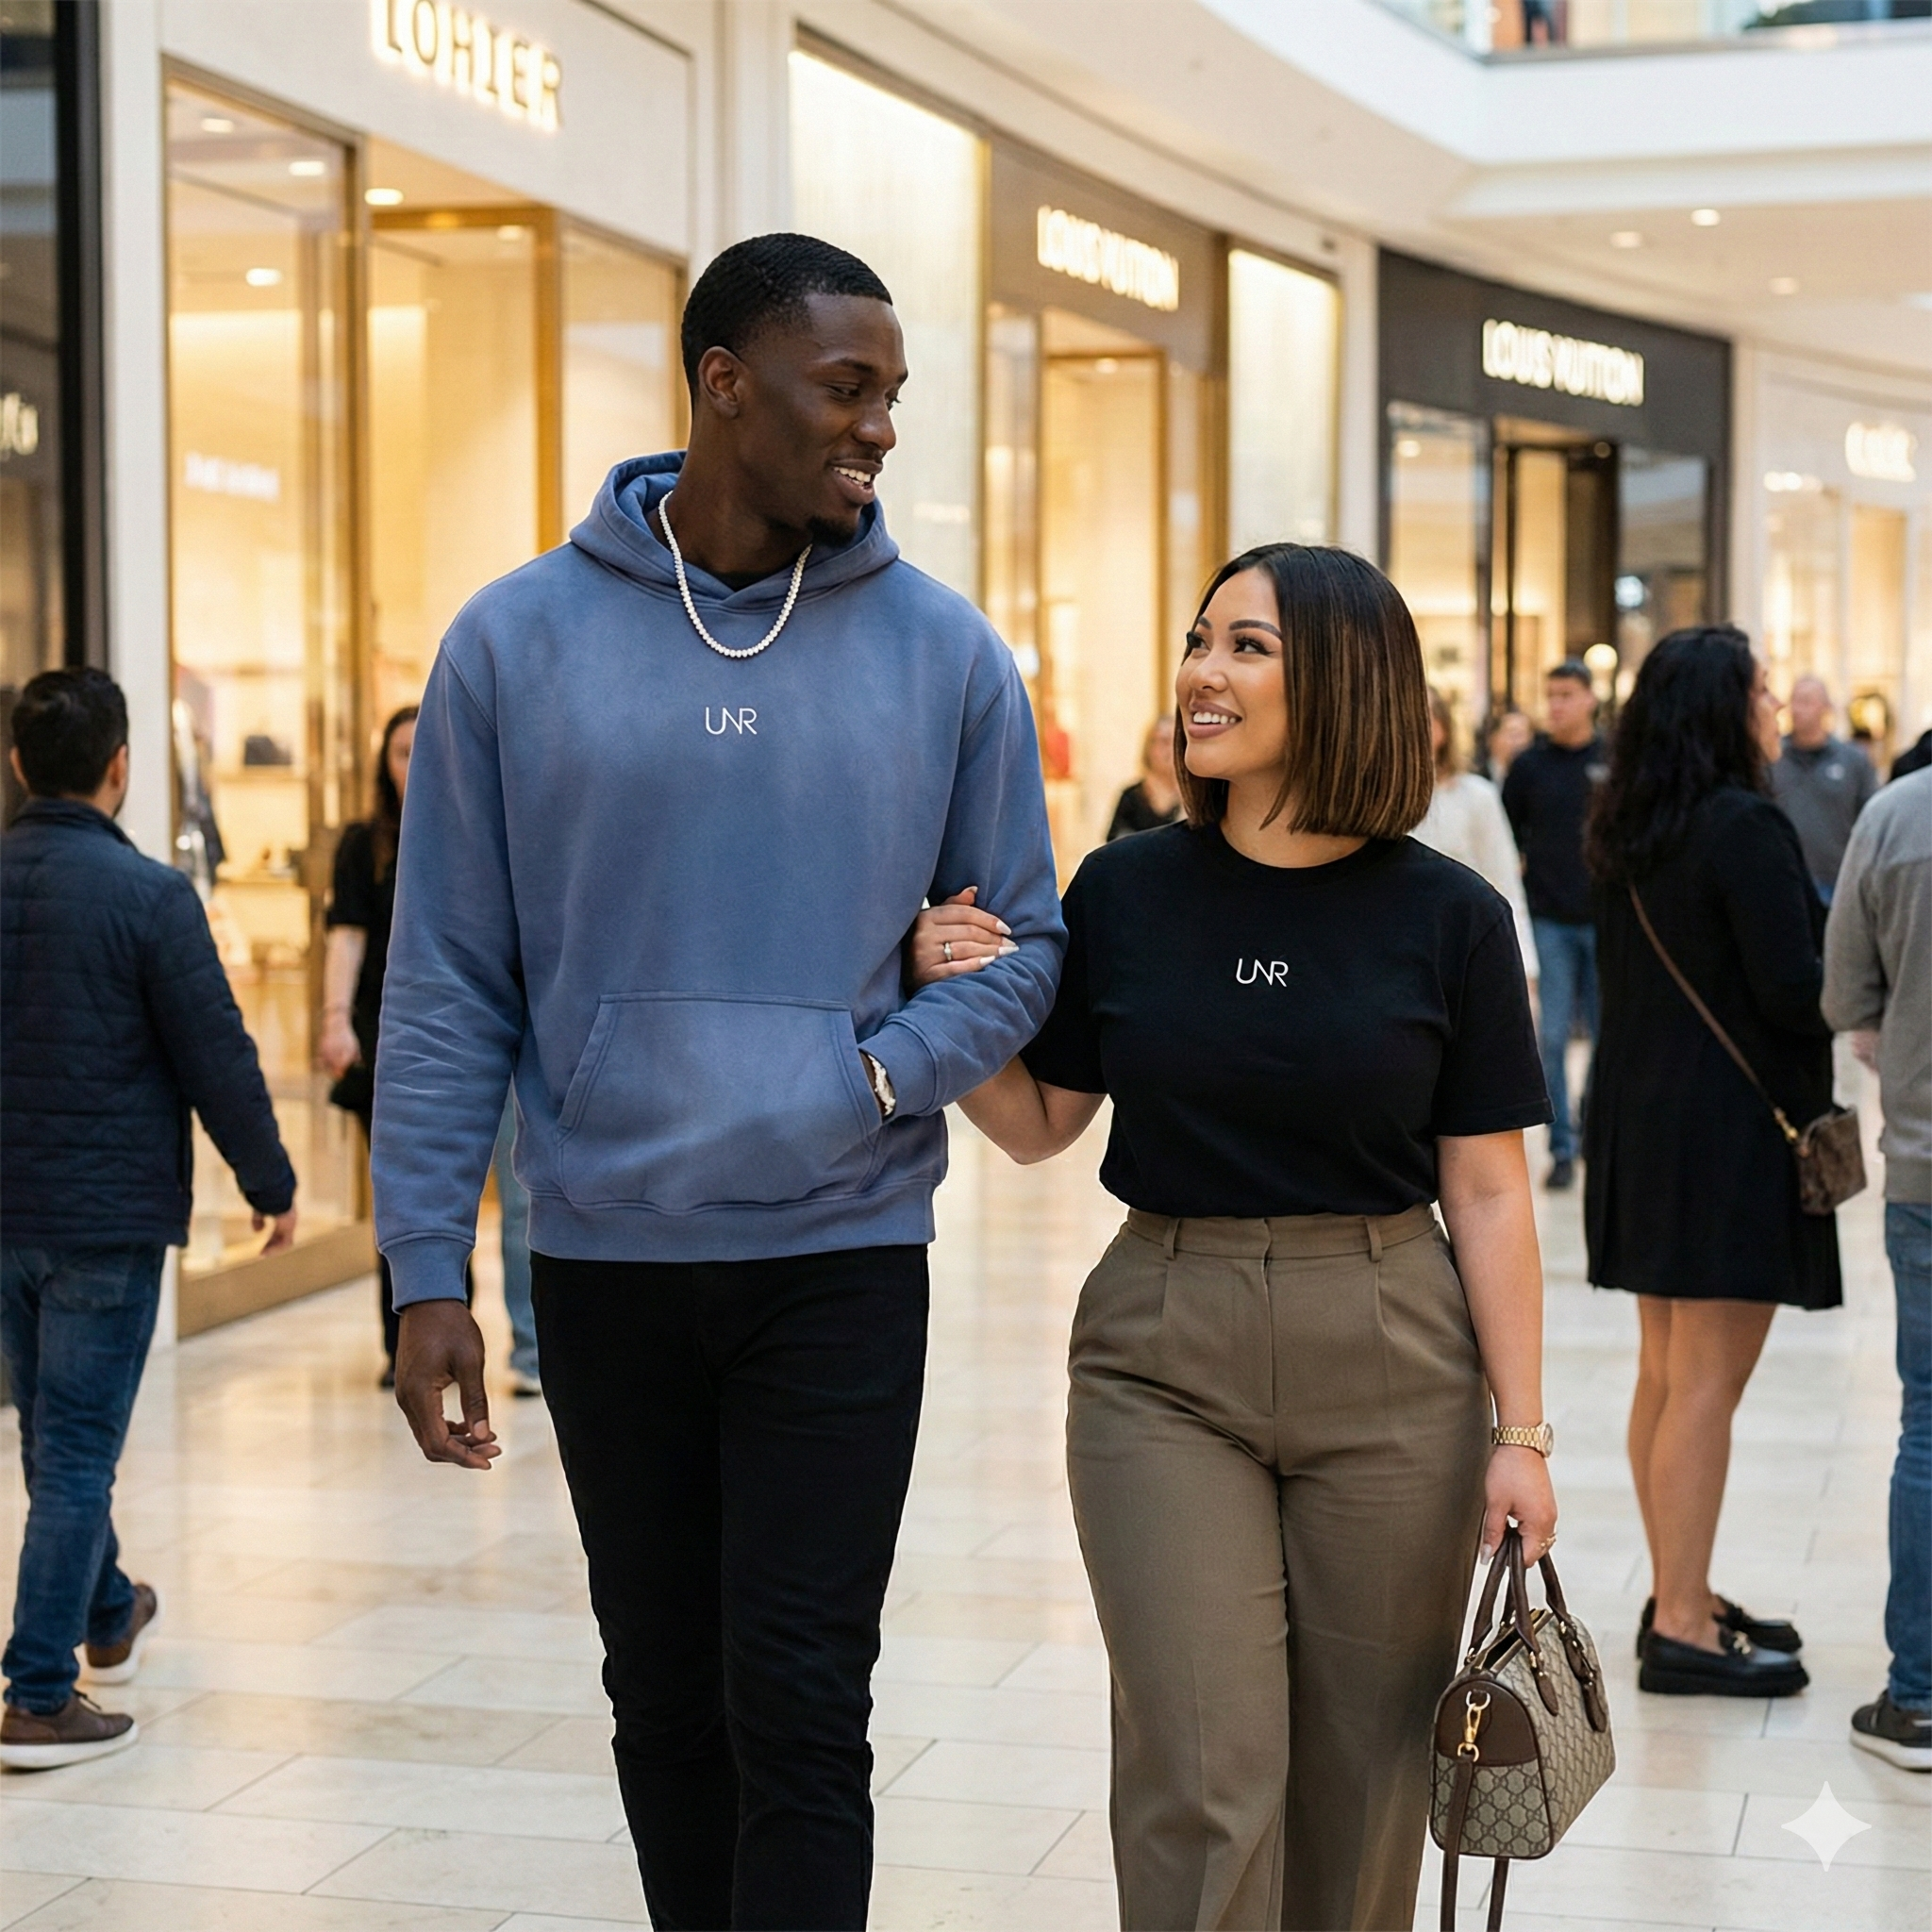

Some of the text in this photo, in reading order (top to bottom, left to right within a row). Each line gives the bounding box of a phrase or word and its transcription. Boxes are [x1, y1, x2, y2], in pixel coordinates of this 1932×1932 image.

[1483, 318, 1553, 389] LOUIS
[705, 707, 758, 735] UNR
[1236, 958, 1289, 988] UNR
